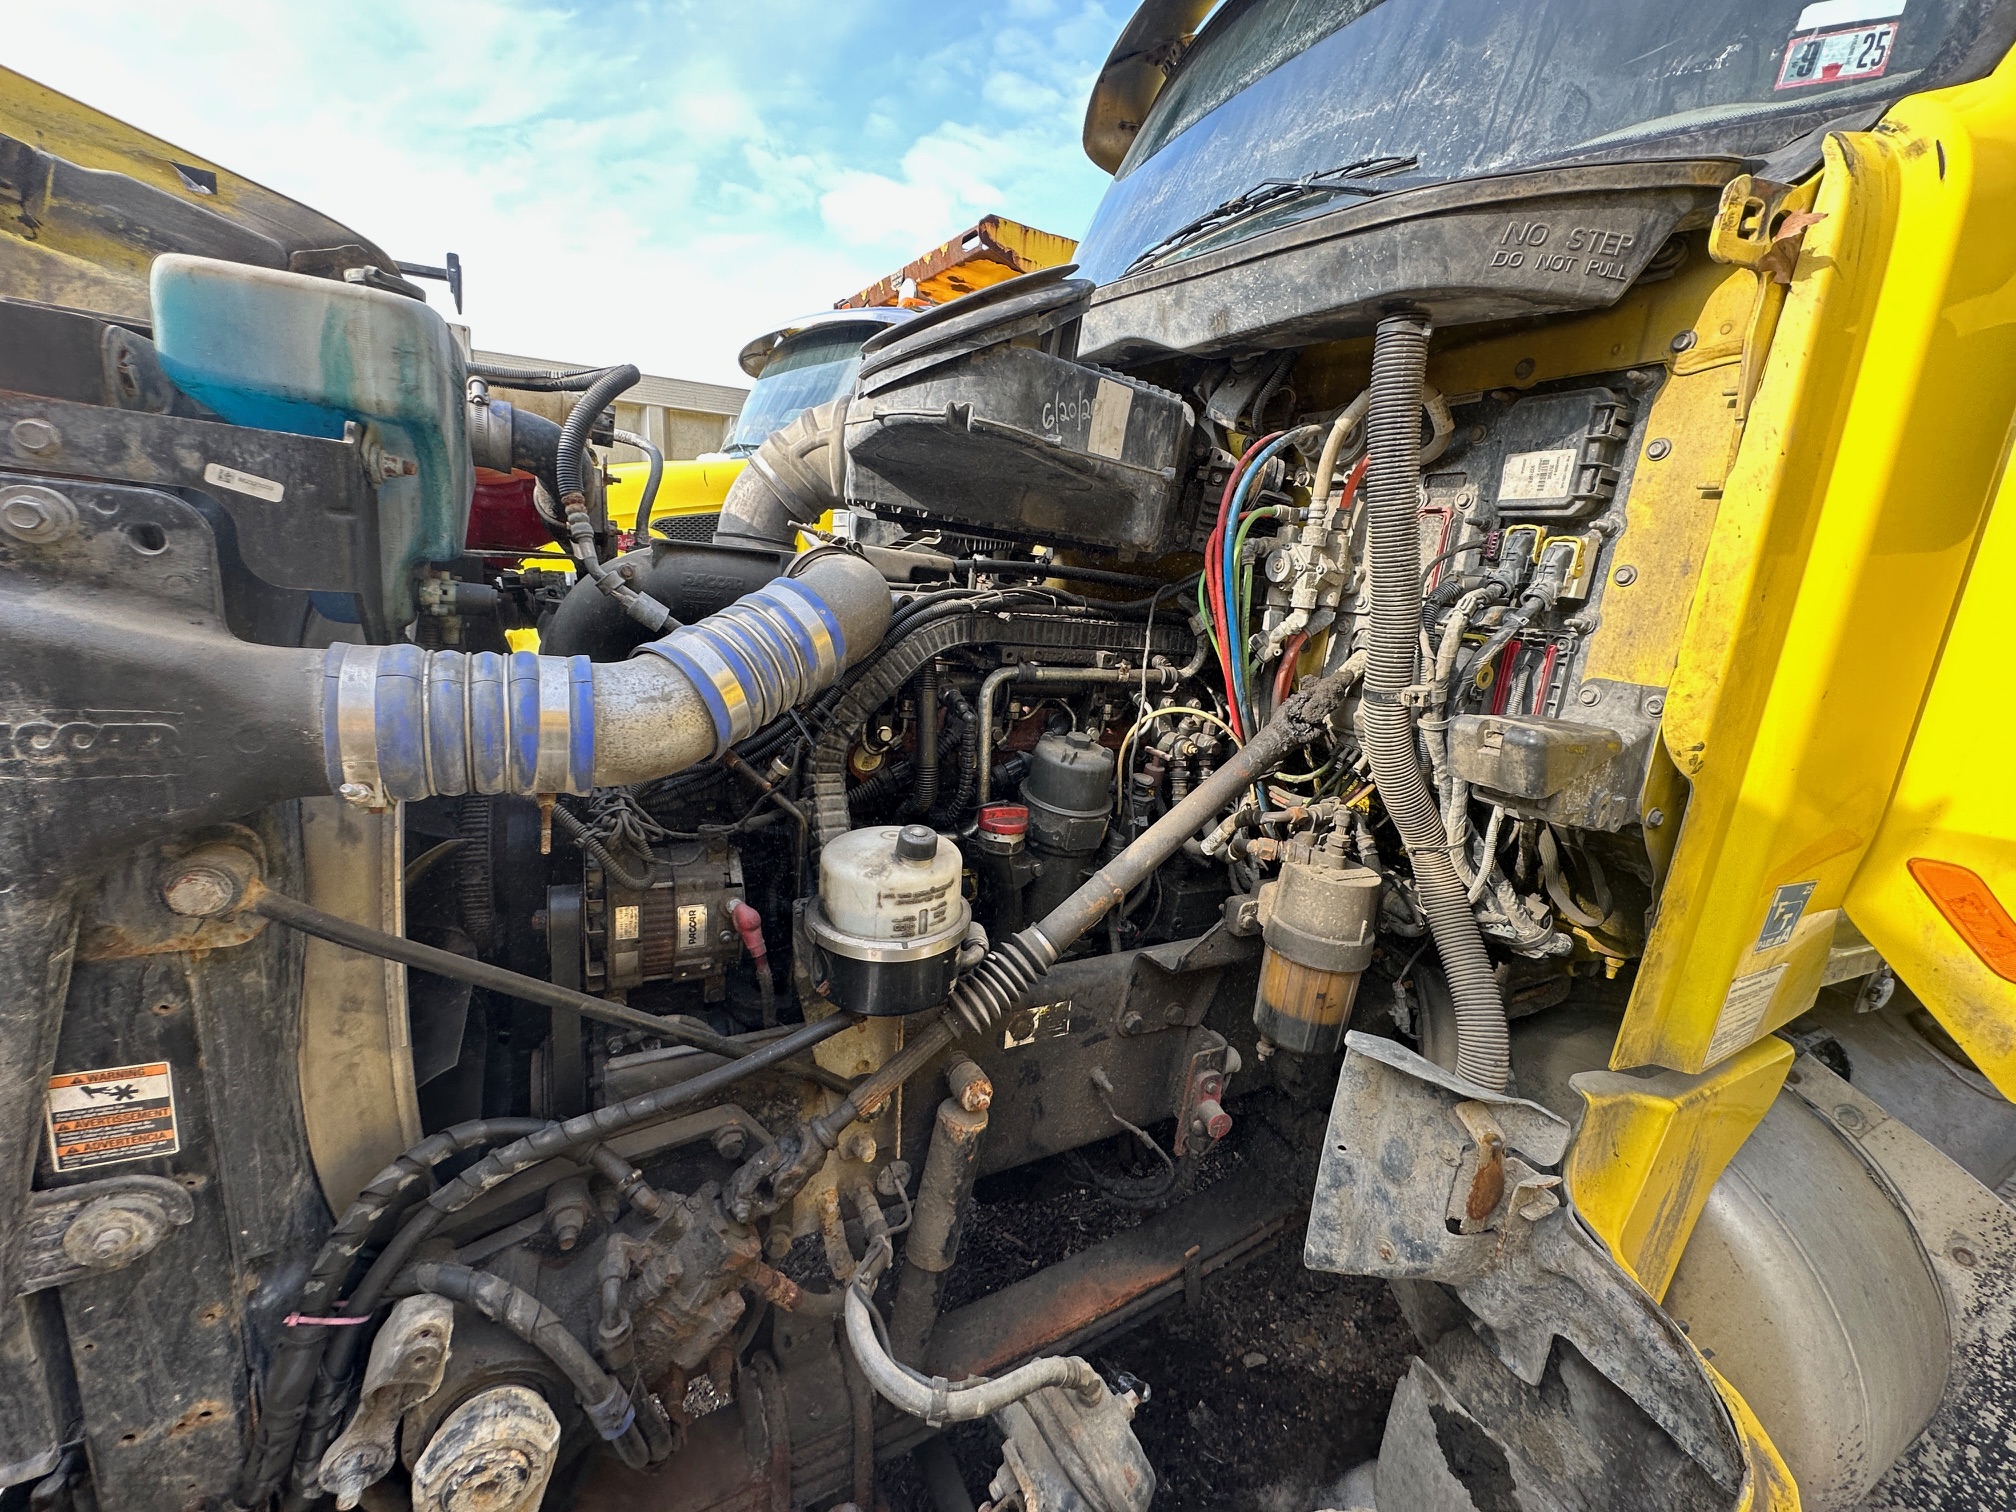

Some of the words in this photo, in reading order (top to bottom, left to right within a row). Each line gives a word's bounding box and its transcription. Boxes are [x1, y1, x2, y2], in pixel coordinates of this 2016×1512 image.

[1796, 41, 1820, 77] 9
[1856, 31, 1890, 69] 25
[1501, 221, 1550, 247] NO
[1566, 227, 1634, 256] STEP
[1490, 250, 1525, 268] DO
[1535, 253, 1578, 273] NOT
[1585, 259, 1627, 282] PULL
[682, 572, 745, 591] PACCAR
[1802, 884, 1815, 895] 25
[688, 909, 697, 945] PACCAR
[87, 1068, 145, 1082] WARNING
[74, 1108, 169, 1129] AVERTISSEMENT
[84, 1131, 167, 1152] ADVERTENCIA
